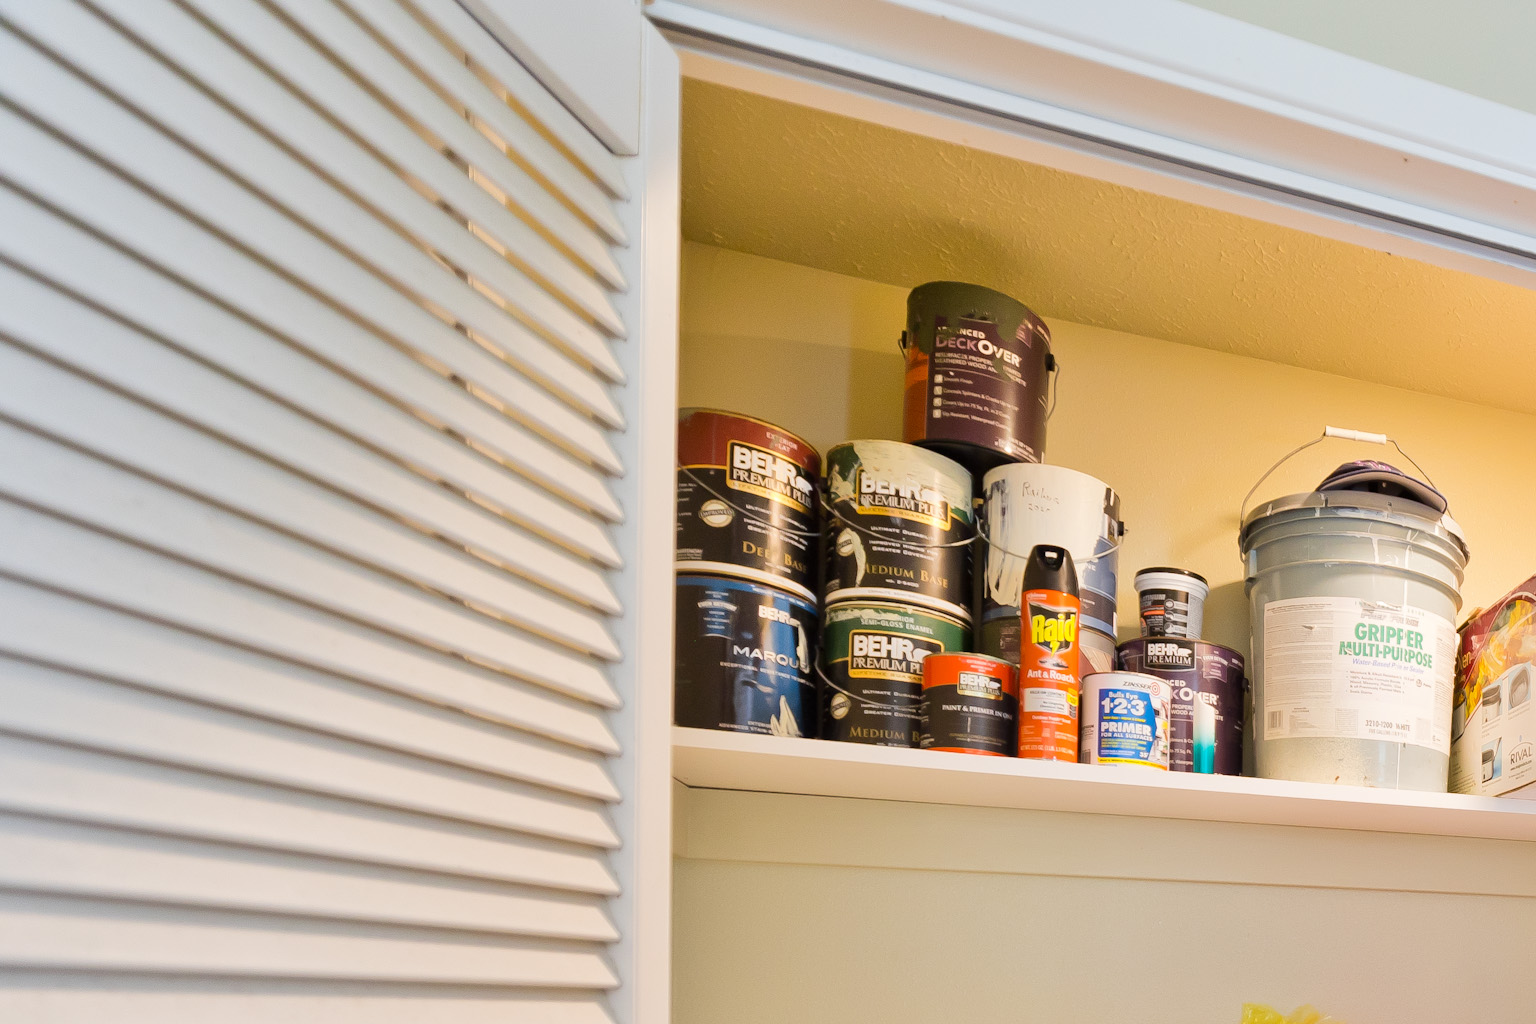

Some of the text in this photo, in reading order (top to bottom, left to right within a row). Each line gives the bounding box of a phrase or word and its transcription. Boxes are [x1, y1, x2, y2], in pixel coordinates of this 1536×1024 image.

[733, 445, 797, 486] BEHR
[733, 469, 812, 508] PREMIUM PLUS
[860, 495, 915, 511] PREMIUM
[920, 570, 948, 588] BASE
[758, 605, 791, 624] BEHR
[861, 619, 904, 628] SEMI-GLOSS
[906, 623, 934, 635] ENAMEL
[1032, 613, 1076, 644] Raid
[1354, 622, 1424, 650] GRIPPER
[853, 635, 914, 660] BEHR
[1147, 643, 1179, 656] BEHR
[1339, 641, 1433, 669] MULTI-PURPOSE
[853, 659, 924, 674] PREMIUM PL
[1147, 656, 1192, 665] PREMIUM
[960, 673, 990, 688] BEHR
[1027, 669, 1042, 679] Ant
[1050, 670, 1075, 684] Roach
[1123, 681, 1152, 690] ZINSSER
[969, 705, 994, 716] PRIMER
[849, 727, 905, 740] MEDIUM
[1101, 722, 1152, 736] PRIMER
[1126, 733, 1153, 742] SURFACES
[1510, 747, 1534, 765] RIVAL
